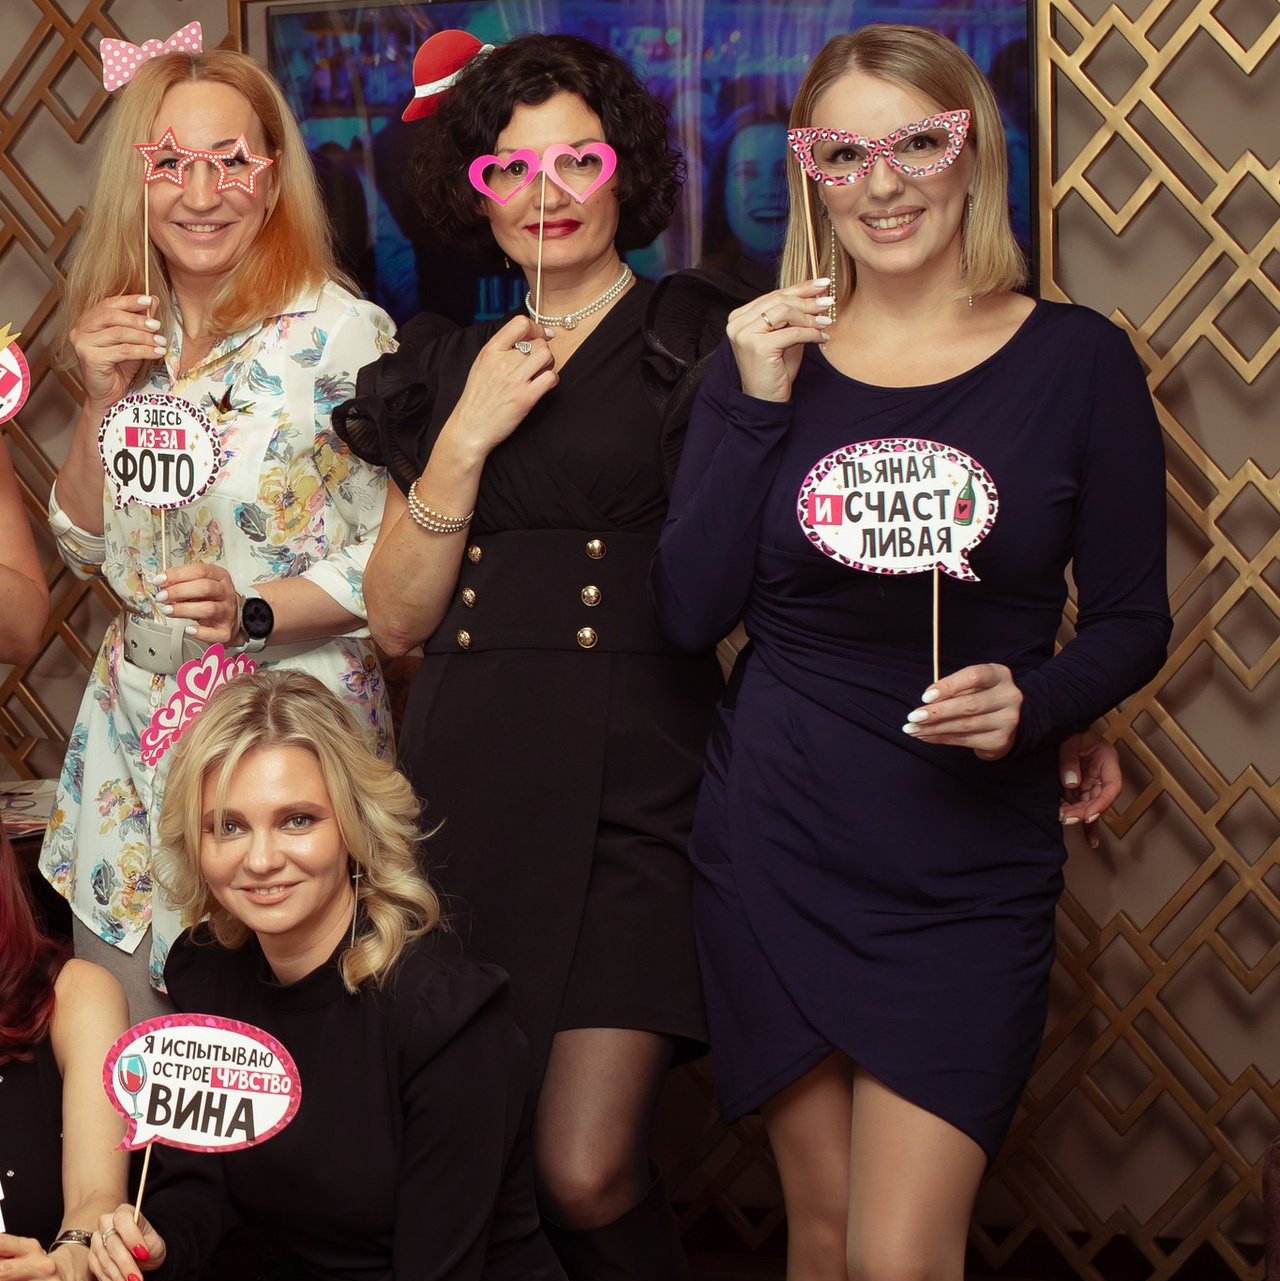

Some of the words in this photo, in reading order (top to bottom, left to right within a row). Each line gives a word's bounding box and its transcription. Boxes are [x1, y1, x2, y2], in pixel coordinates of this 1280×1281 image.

[132, 407, 140, 423] Я
[143, 409, 182, 427] ЗДЕСЬ
[137, 428, 178, 449] ИЗ-ЗА
[113, 448, 195, 498] ФОТО
[842, 454, 937, 488] ПЬЯНАЯ
[815, 497, 832, 522] И
[844, 489, 950, 523] СЧАСТ
[860, 526, 952, 559] ЛИВАЯ
[143, 1035, 155, 1054] Я
[161, 1036, 274, 1068] ИСПЫТЫВАЮ
[153, 1061, 211, 1084] ОСТРОЕ
[216, 1067, 291, 1094] ЧУВСТВО
[146, 1082, 256, 1141] ВИНА
